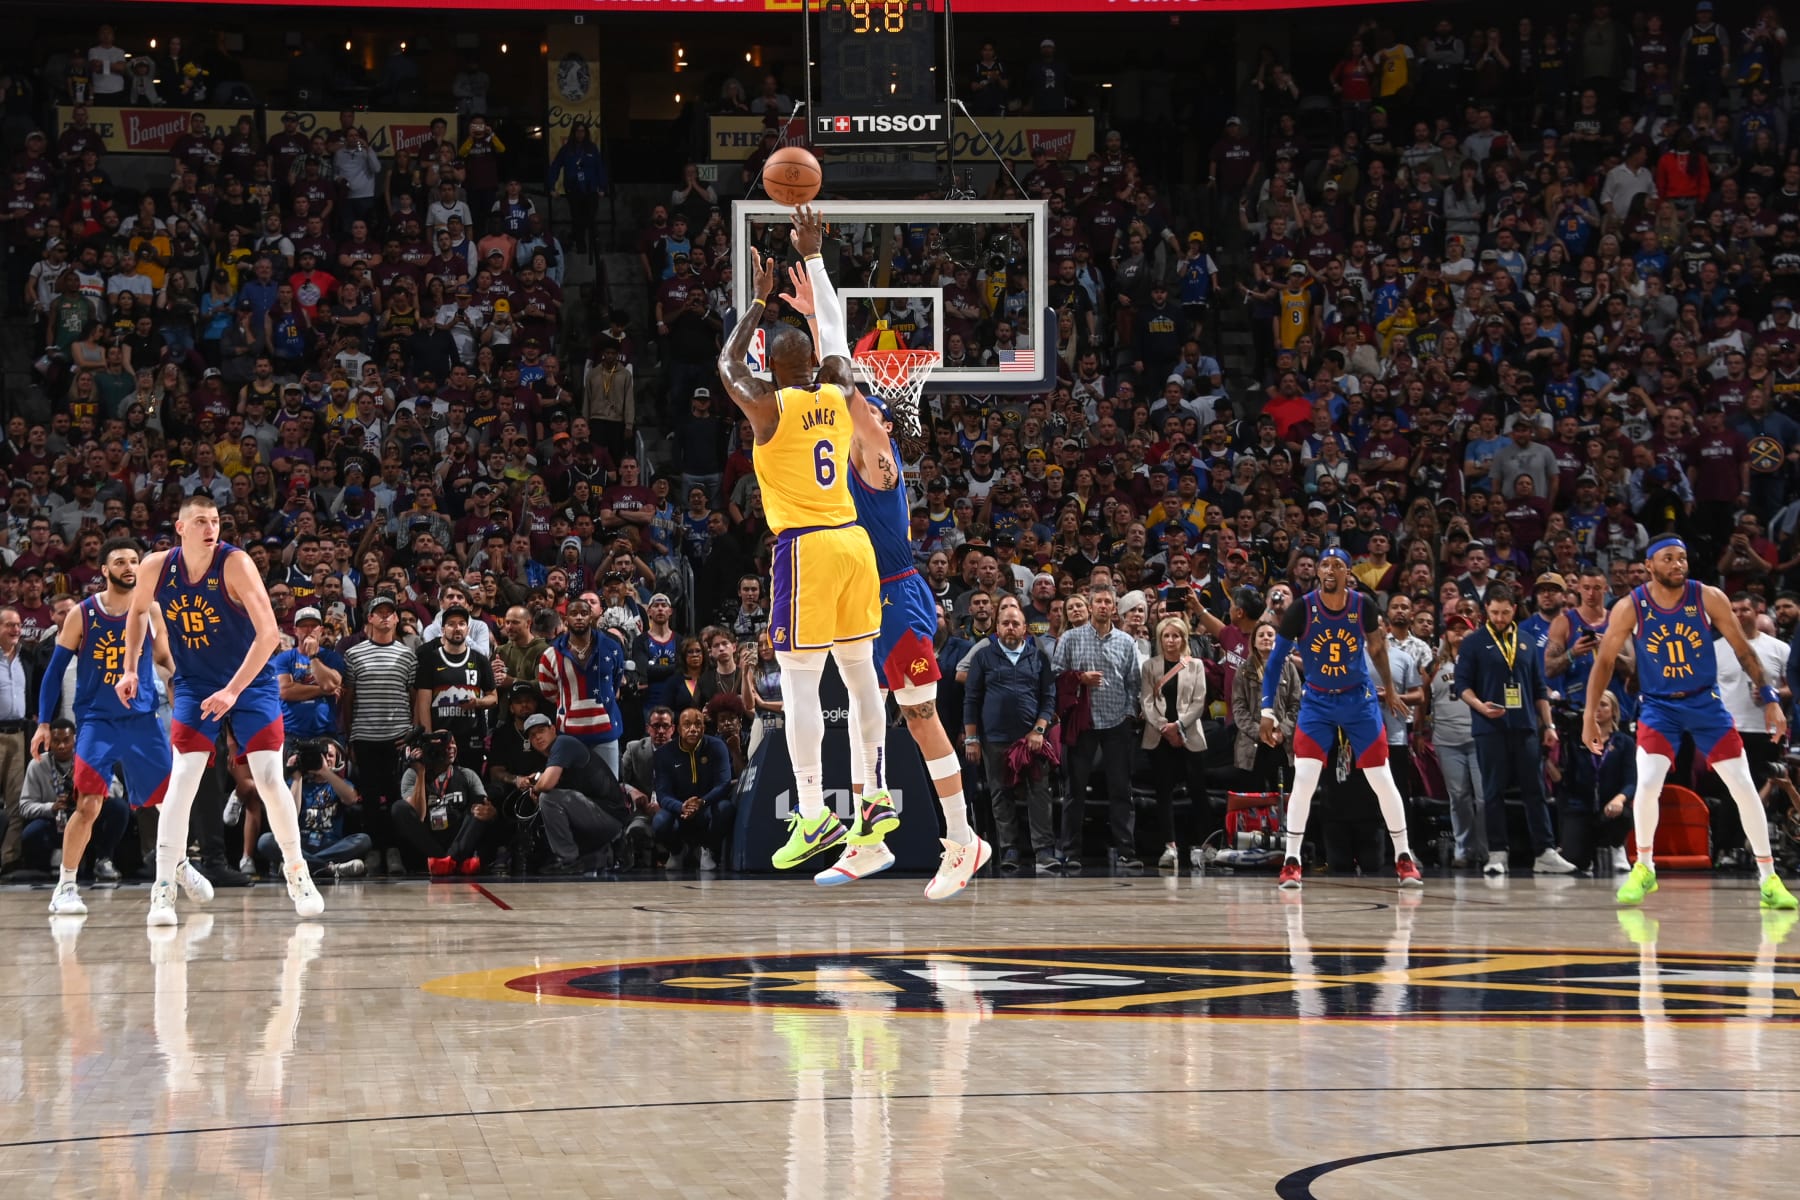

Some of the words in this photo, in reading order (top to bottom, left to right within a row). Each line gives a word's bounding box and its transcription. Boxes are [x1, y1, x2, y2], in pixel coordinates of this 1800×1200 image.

[850, 0, 904, 33] 9.8
[129, 115, 187, 146] Banquet
[852, 114, 942, 132] TISSOT
[395, 128, 433, 150] Banque
[716, 132, 762, 147] THE
[1032, 132, 1072, 151] Banquet
[1291, 310, 1301, 323] 8
[287, 326, 297, 337] 15
[374, 395, 384, 406] 15
[802, 408, 836, 430] JAMES
[813, 439, 836, 490] 6
[170, 564, 177, 573] 6
[88, 609, 95, 617] 6
[166, 594, 190, 621] MILE
[195, 595, 221, 624] HIGH
[181, 611, 205, 633] 15
[93, 630, 117, 660] MILE
[1310, 628, 1333, 654] MILE
[1337, 628, 1358, 653] HIGH
[1646, 623, 1670, 654] MILE
[1675, 622, 1703, 649] HIGH
[1329, 642, 1341, 663] 5
[1666, 640, 1685, 663] 11
[103, 671, 124, 685] CIT
[465, 669, 477, 685] 13
[1320, 663, 1348, 677] CITY
[1663, 663, 1694, 678] CITY
[822, 706, 849, 723] ogle
[436, 791, 463, 806] SPN
